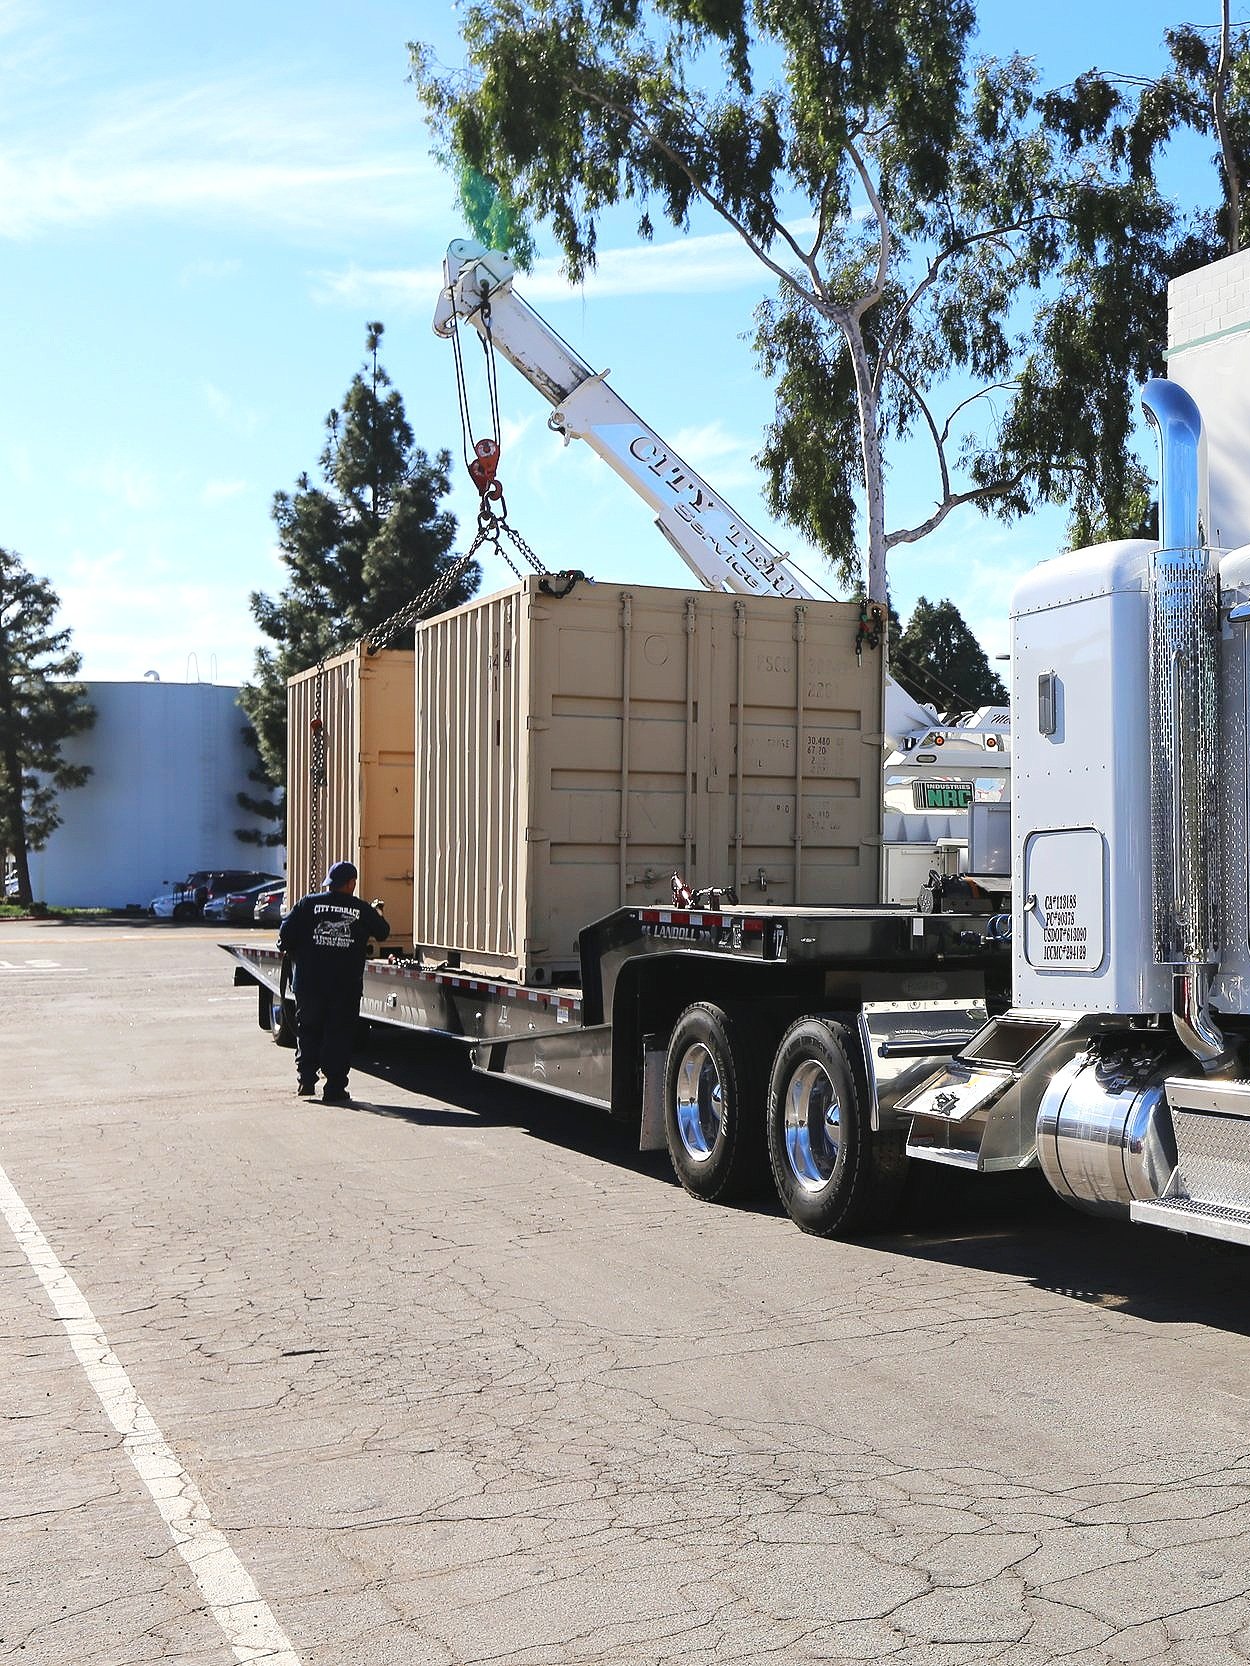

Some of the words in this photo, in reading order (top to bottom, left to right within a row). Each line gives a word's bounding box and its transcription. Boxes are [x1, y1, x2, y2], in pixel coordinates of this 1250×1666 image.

[630, 436, 714, 514] CITY
[673, 502, 760, 589] Service
[927, 789, 972, 807] NRC
[313, 904, 330, 915] CITY
[330, 905, 361, 920] TERRACE
[653, 925, 697, 942] LANDOLL
